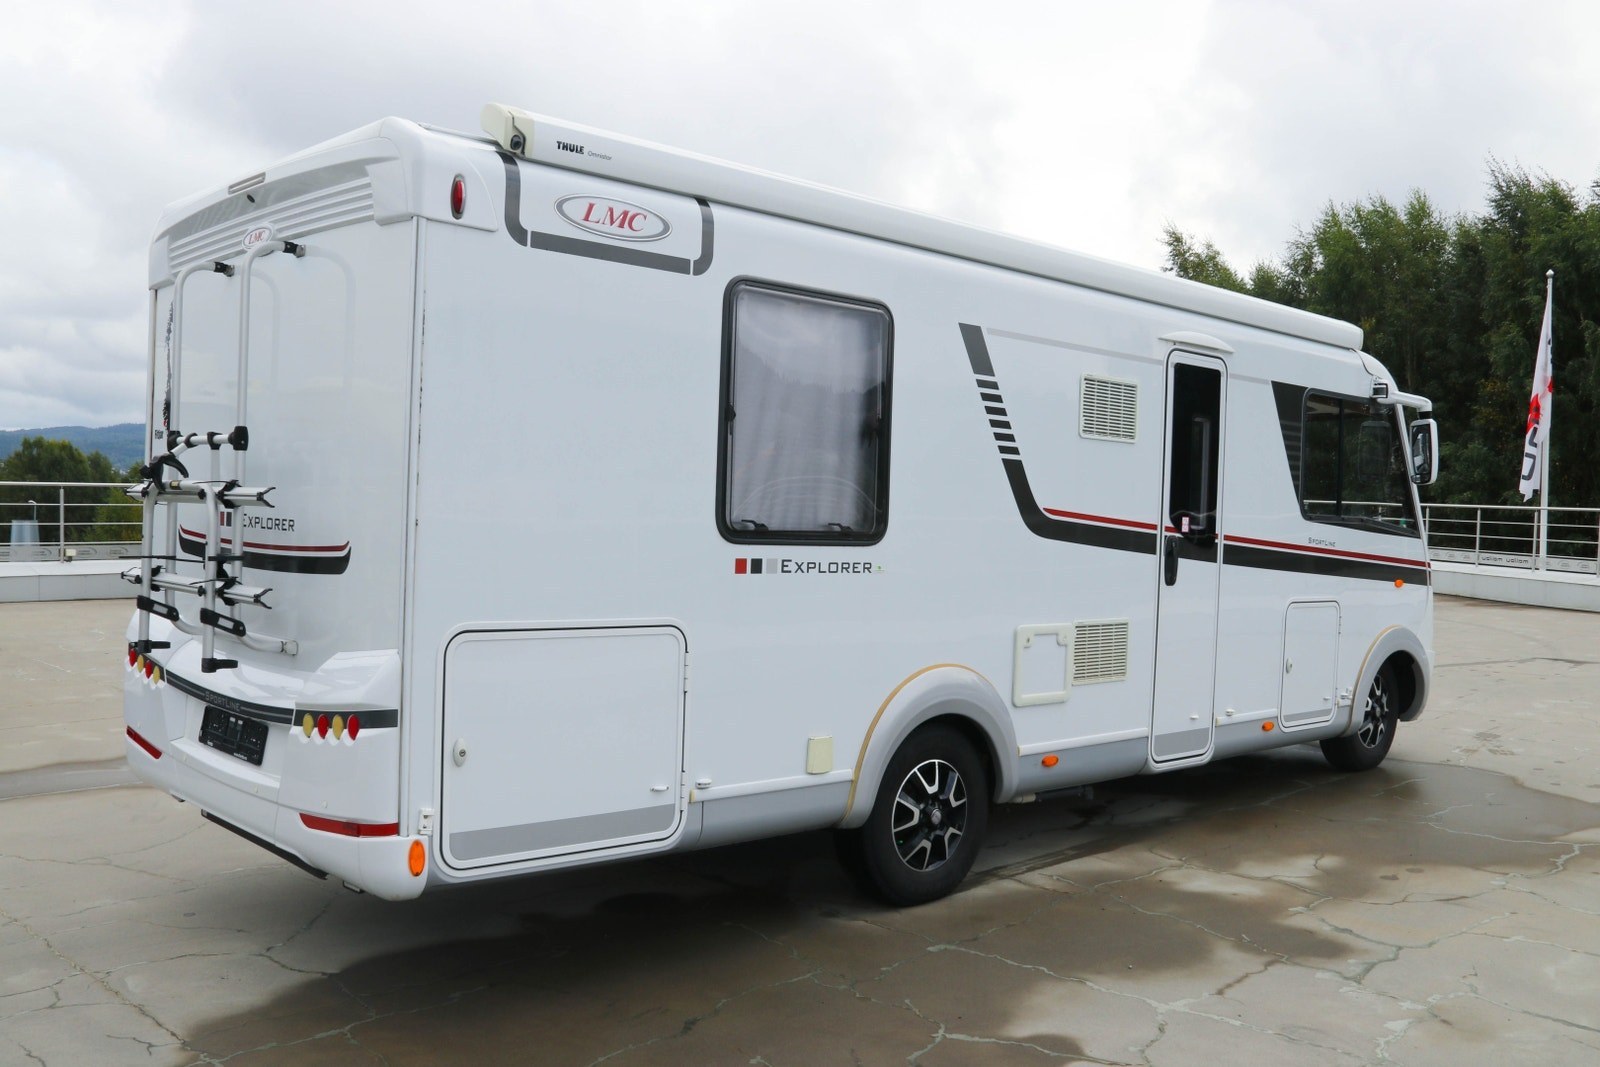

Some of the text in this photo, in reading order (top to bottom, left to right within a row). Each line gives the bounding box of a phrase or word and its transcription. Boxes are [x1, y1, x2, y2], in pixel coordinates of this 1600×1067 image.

[556, 140, 613, 161] THULE Omnistor
[581, 202, 648, 232] LMC
[248, 230, 266, 245] LMC
[780, 559, 873, 574] EXPLORER
[205, 691, 241, 712] SPORTLINE
